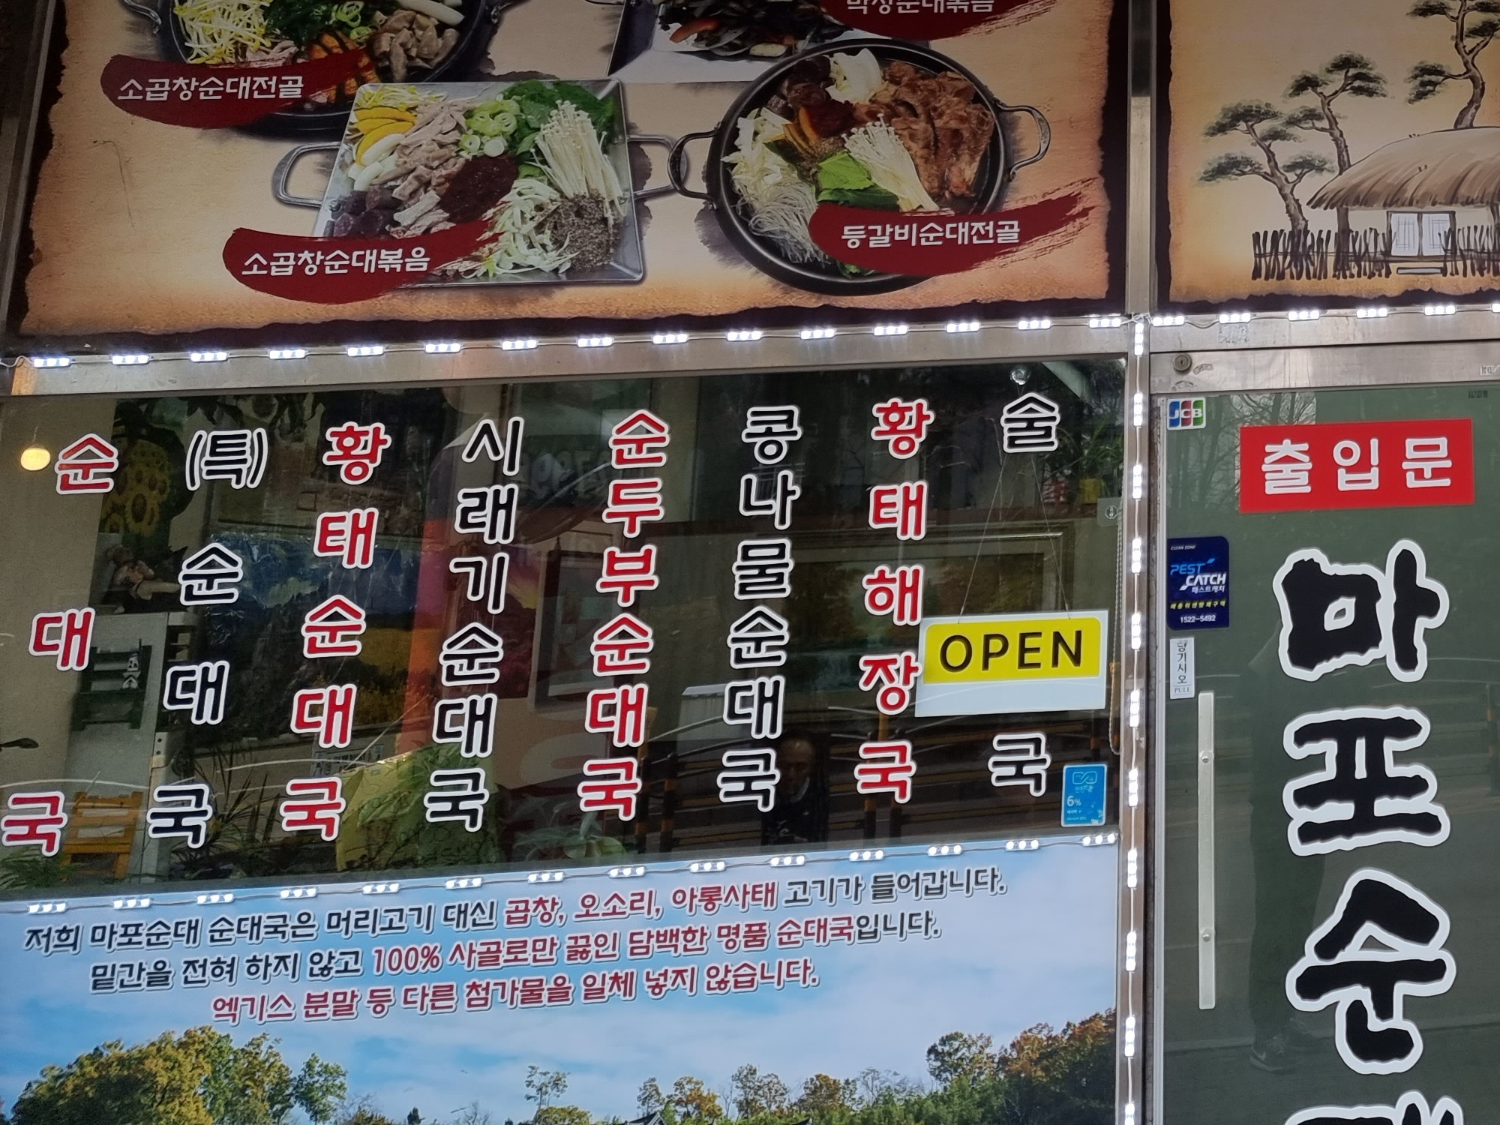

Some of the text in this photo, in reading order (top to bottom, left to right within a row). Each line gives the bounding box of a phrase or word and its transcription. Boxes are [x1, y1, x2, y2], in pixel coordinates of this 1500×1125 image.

[117, 75, 304, 102] 소곱창순대전골
[241, 247, 430, 277] 소곱창순대볶음
[841, 219, 1021, 249] 등갈비순대전골
[1169, 408, 1204, 419] JCB
[1261, 435, 1452, 497] 출입문
[854, 397, 935, 804] 황태해장국
[1170, 563, 1206, 576] PEST
[1185, 573, 1227, 587] CATCH
[1, 432, 119, 856] 순대국
[280, 421, 391, 841] 황태순대국
[424, 416, 525, 832] 시래기순대국
[577, 408, 671, 821] 순두부순대국
[717, 404, 803, 813] 콩나물순대국
[938, 629, 1086, 674] OPEN
[1272, 539, 1464, 1125] 마포순
[25, 867, 1008, 953] 저희 마포순대 순대국은 머리고기 대신 곱창, 오소리, 아롱사태 고기가 들어갑니다.
[89, 909, 943, 993] 밑간을 전혀 하지 않고 100% 사골로만 끓인 담백한 명품 순대국입니다.
[210, 958, 821, 1026] 엑기스 분말 등 다른 첨가물을 일체 넣지 않습니다.
